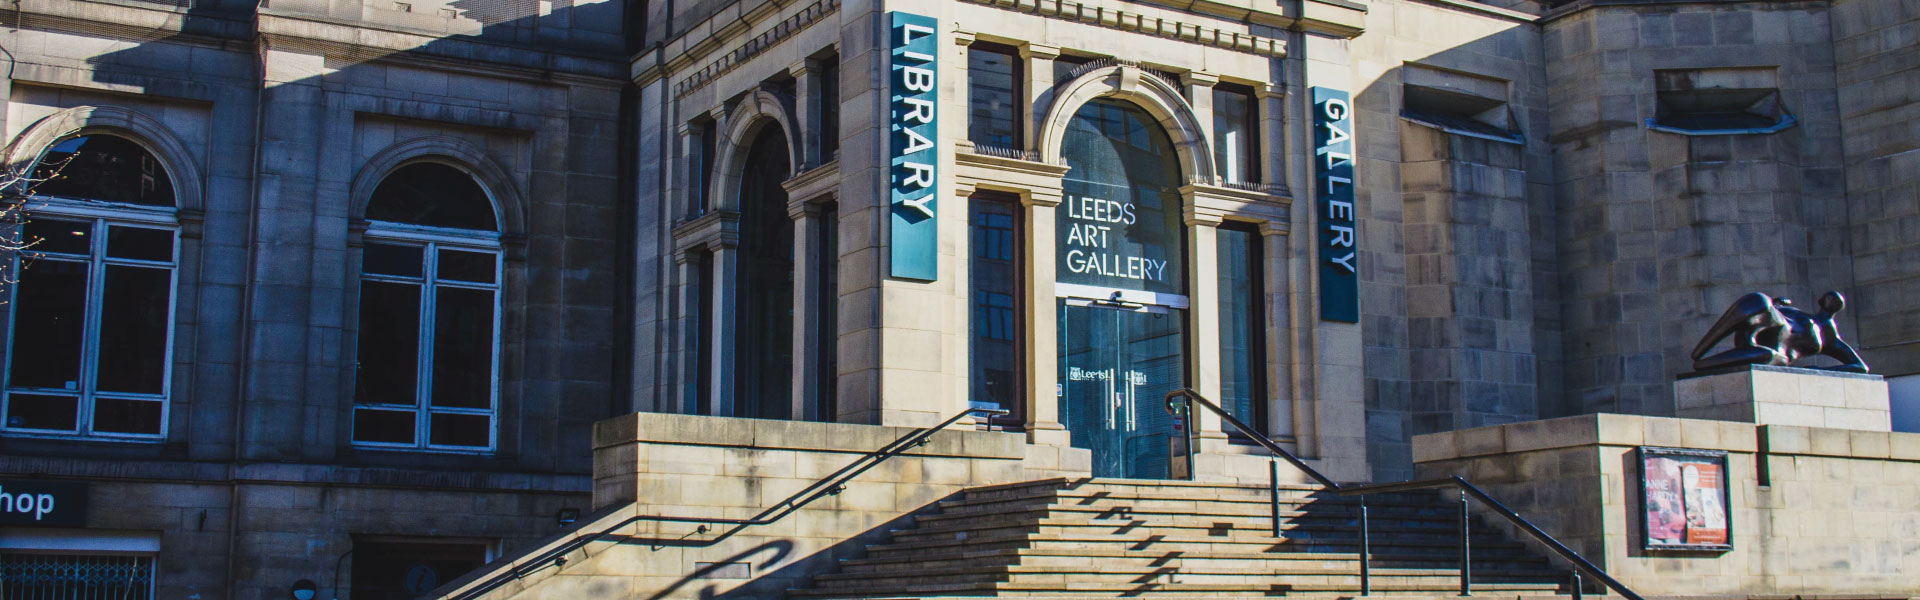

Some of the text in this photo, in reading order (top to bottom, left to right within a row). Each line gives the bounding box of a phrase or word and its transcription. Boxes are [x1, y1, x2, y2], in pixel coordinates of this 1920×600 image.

[903, 23, 935, 219] LIBRARY
[1325, 98, 1355, 273] GALLERY
[1068, 195, 1136, 225] LEEDS
[1067, 223, 1111, 249] ART
[1066, 249, 1167, 281] GALLERY
